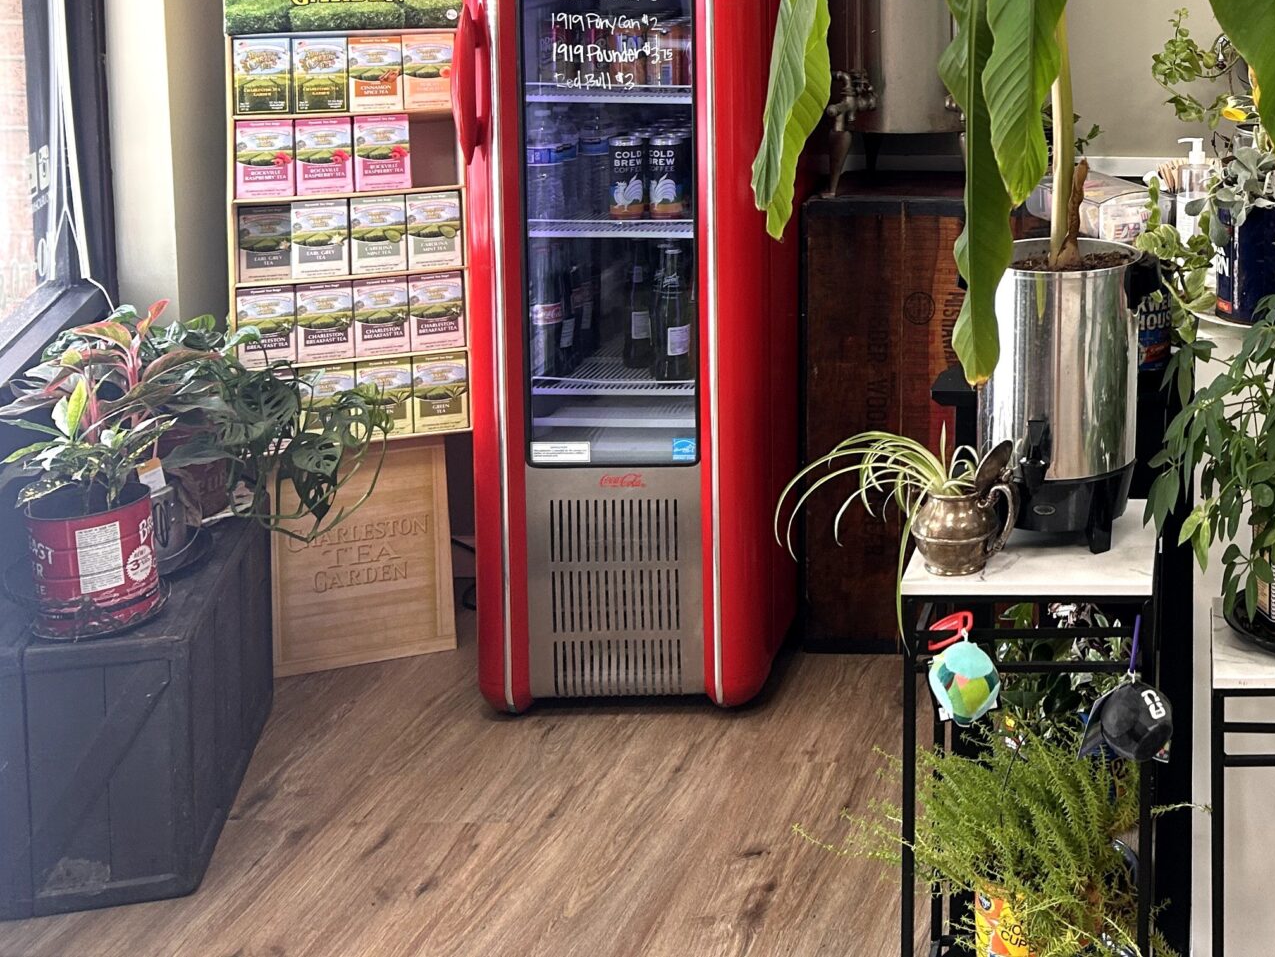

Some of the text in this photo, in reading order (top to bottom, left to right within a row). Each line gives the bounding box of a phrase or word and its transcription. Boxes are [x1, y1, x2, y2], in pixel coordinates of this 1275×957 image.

[551, 12, 585, 32] 1919
[585, 12, 618, 35] Pony
[552, 42, 585, 63] 1919
[586, 41, 645, 63] Pounder
[585, 71, 612, 91] Bull
[613, 158, 643, 167] BREW
[614, 151, 642, 159] COLD
[418, 327, 448, 335] BREAKFAST
[420, 321, 455, 331] CHARLESTON
[599, 474, 647, 488] Coca-Cola
[287, 513, 430, 553] CHARLESTON
[322, 542, 401, 570] TEA
[312, 561, 409, 594] GARDEN
